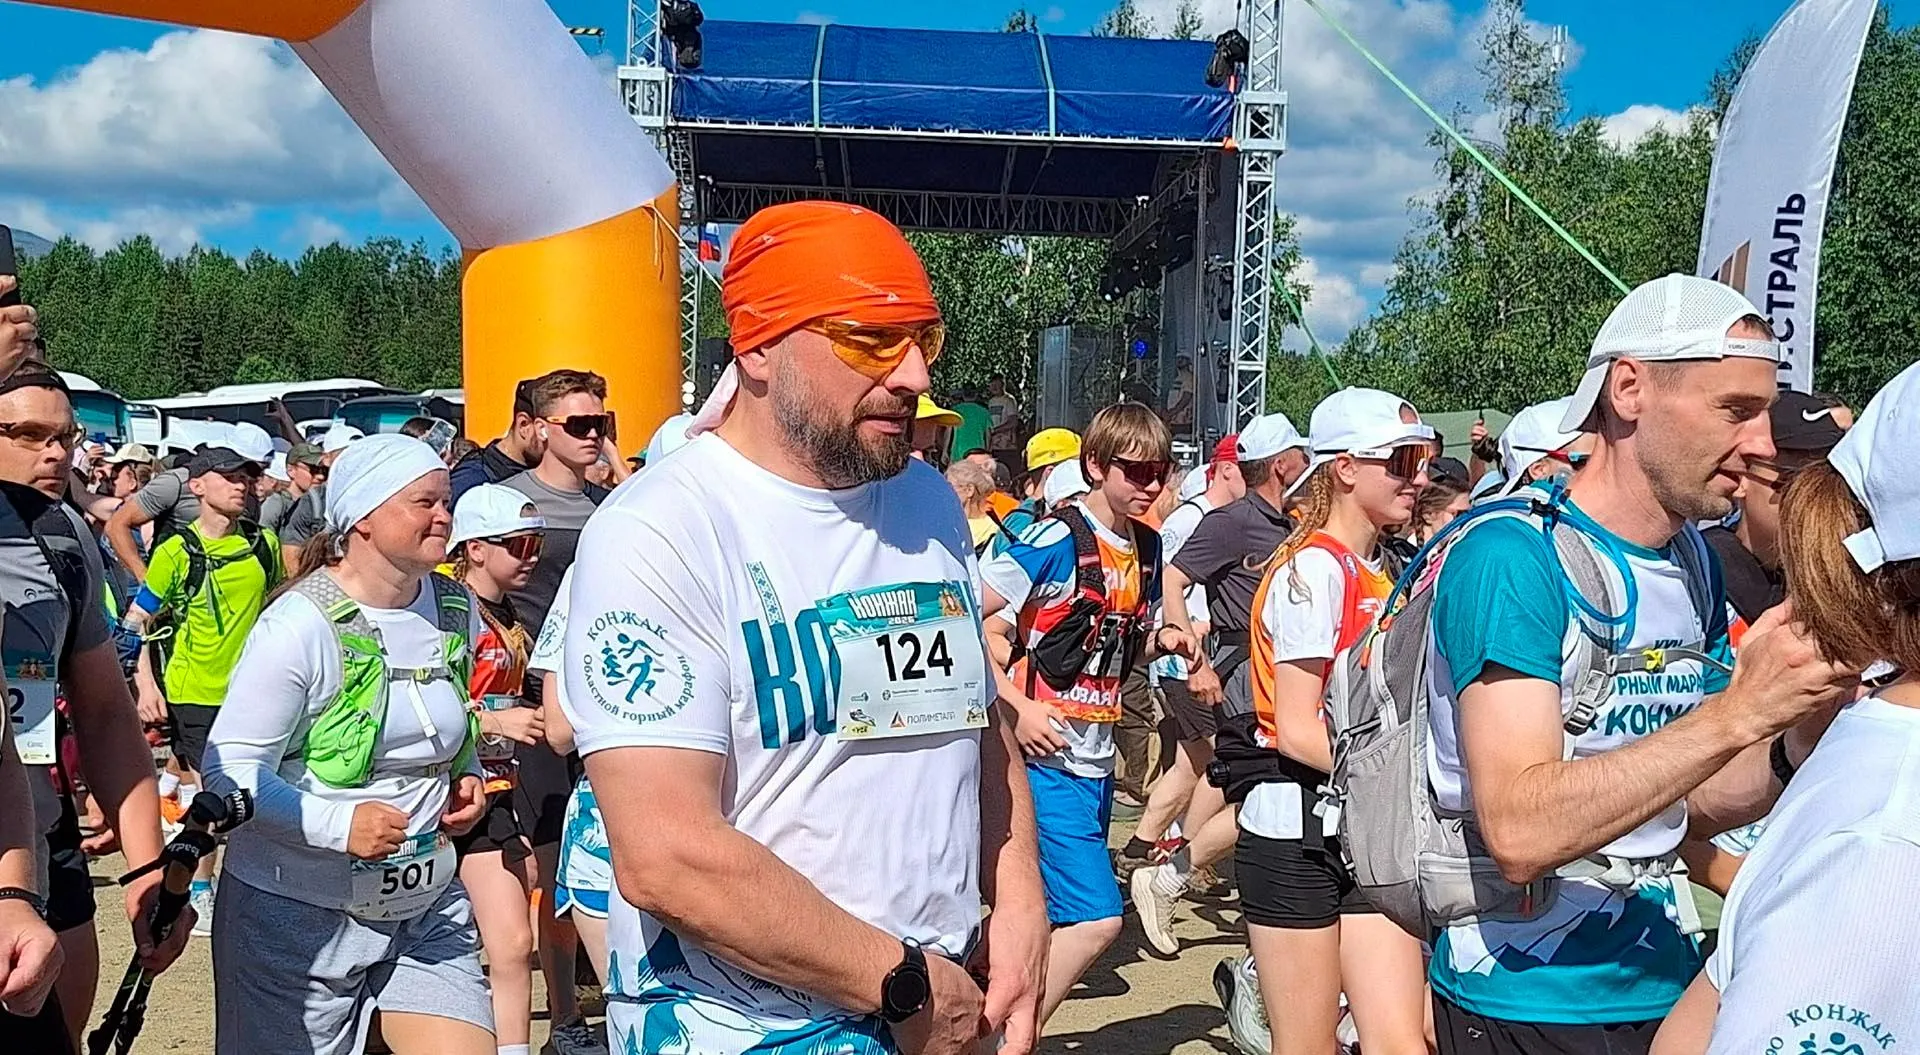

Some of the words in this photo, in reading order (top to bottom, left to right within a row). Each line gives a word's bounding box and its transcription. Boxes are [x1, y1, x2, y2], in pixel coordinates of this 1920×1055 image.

[848, 589, 918, 619] КОНЖАК
[587, 611, 668, 641] КОНЖАК
[876, 630, 953, 681] 124
[584, 654, 619, 715] Областной
[622, 705, 676, 725] горный
[380, 859, 434, 895] 501
[1787, 1003, 1896, 1050] КОНЖАК
